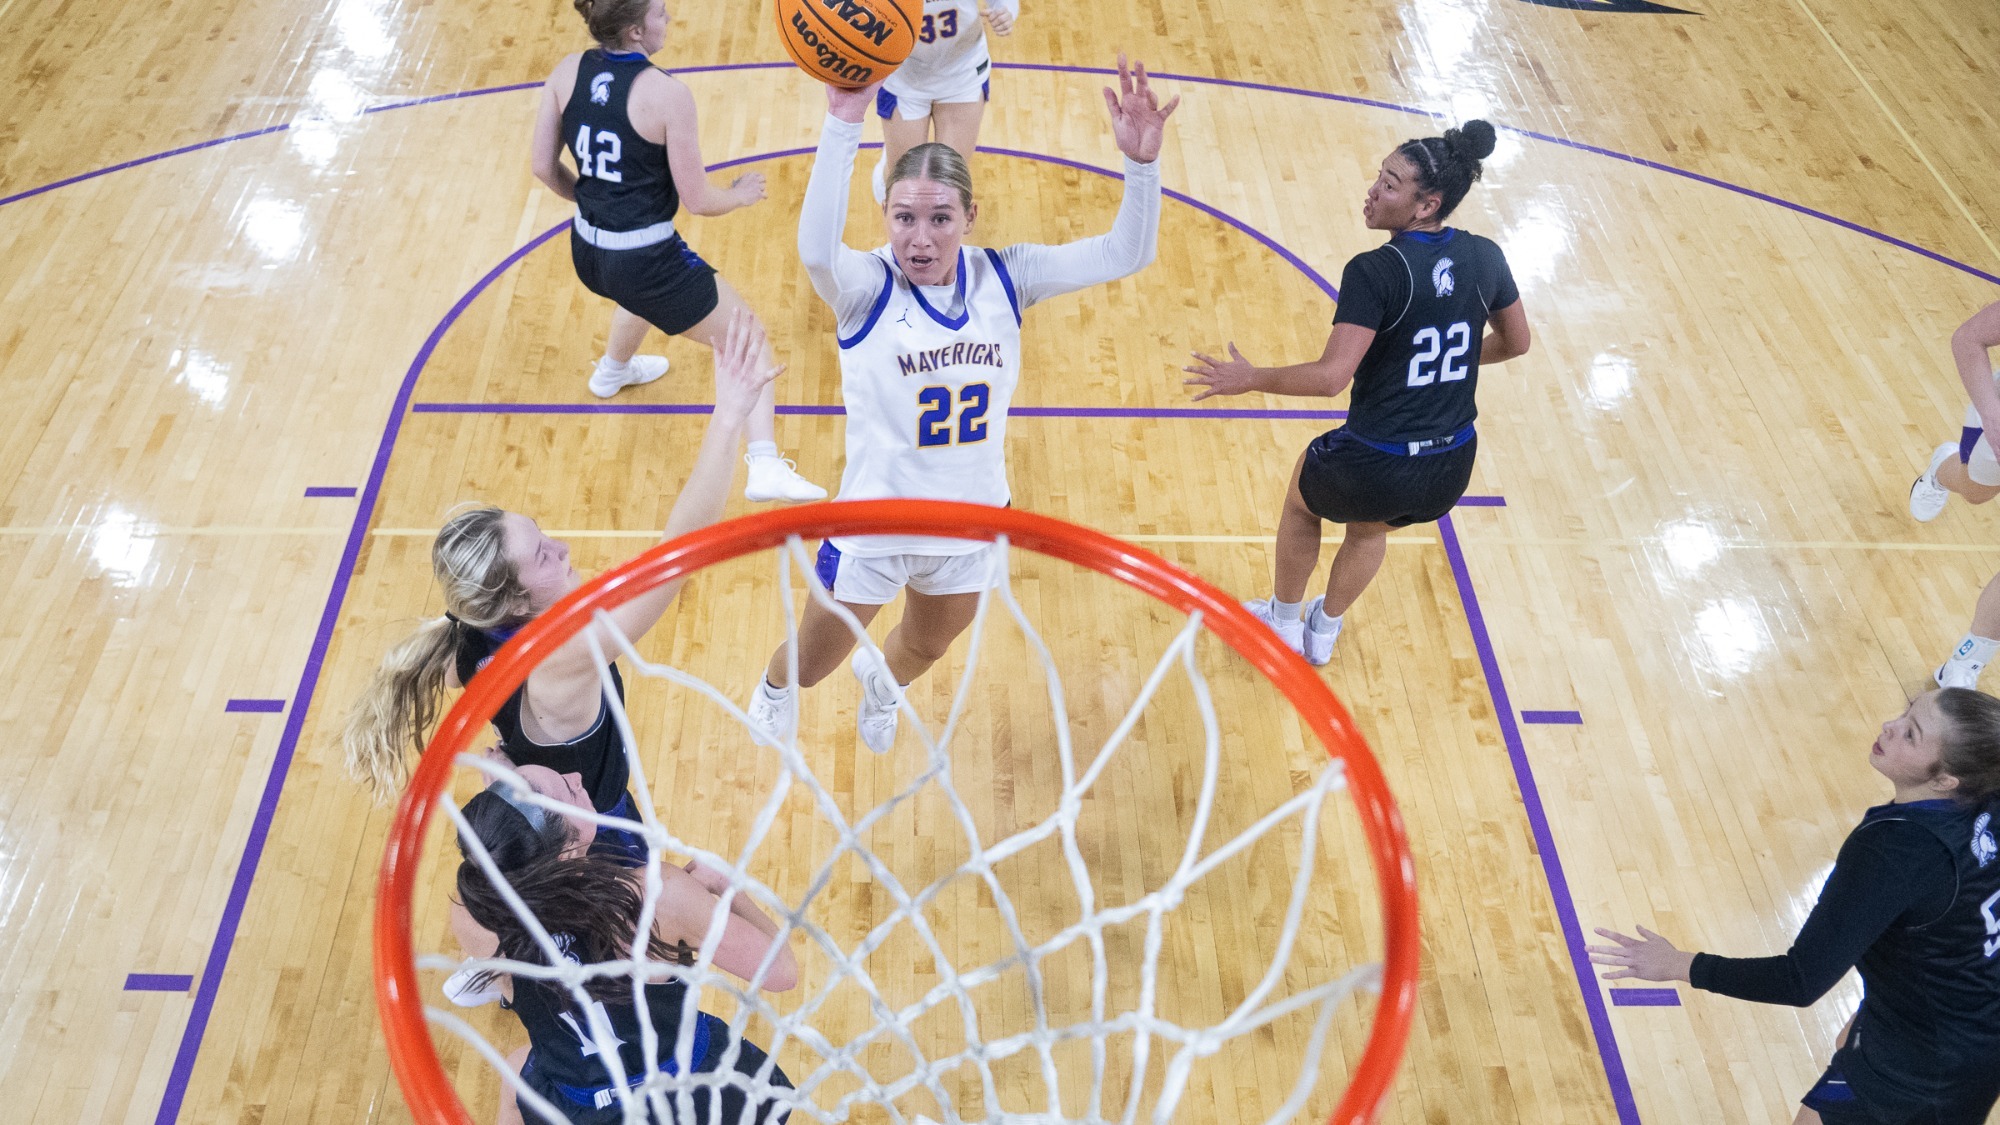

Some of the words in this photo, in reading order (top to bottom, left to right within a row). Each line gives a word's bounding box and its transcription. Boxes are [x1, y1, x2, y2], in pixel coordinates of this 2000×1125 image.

[791, 9, 873, 82] Wilson
[919, 8, 958, 44] 33
[575, 124, 622, 183] 42
[897, 342, 1004, 377] MAVERICKS
[1407, 321, 1471, 387] 22
[916, 380, 992, 450] 22
